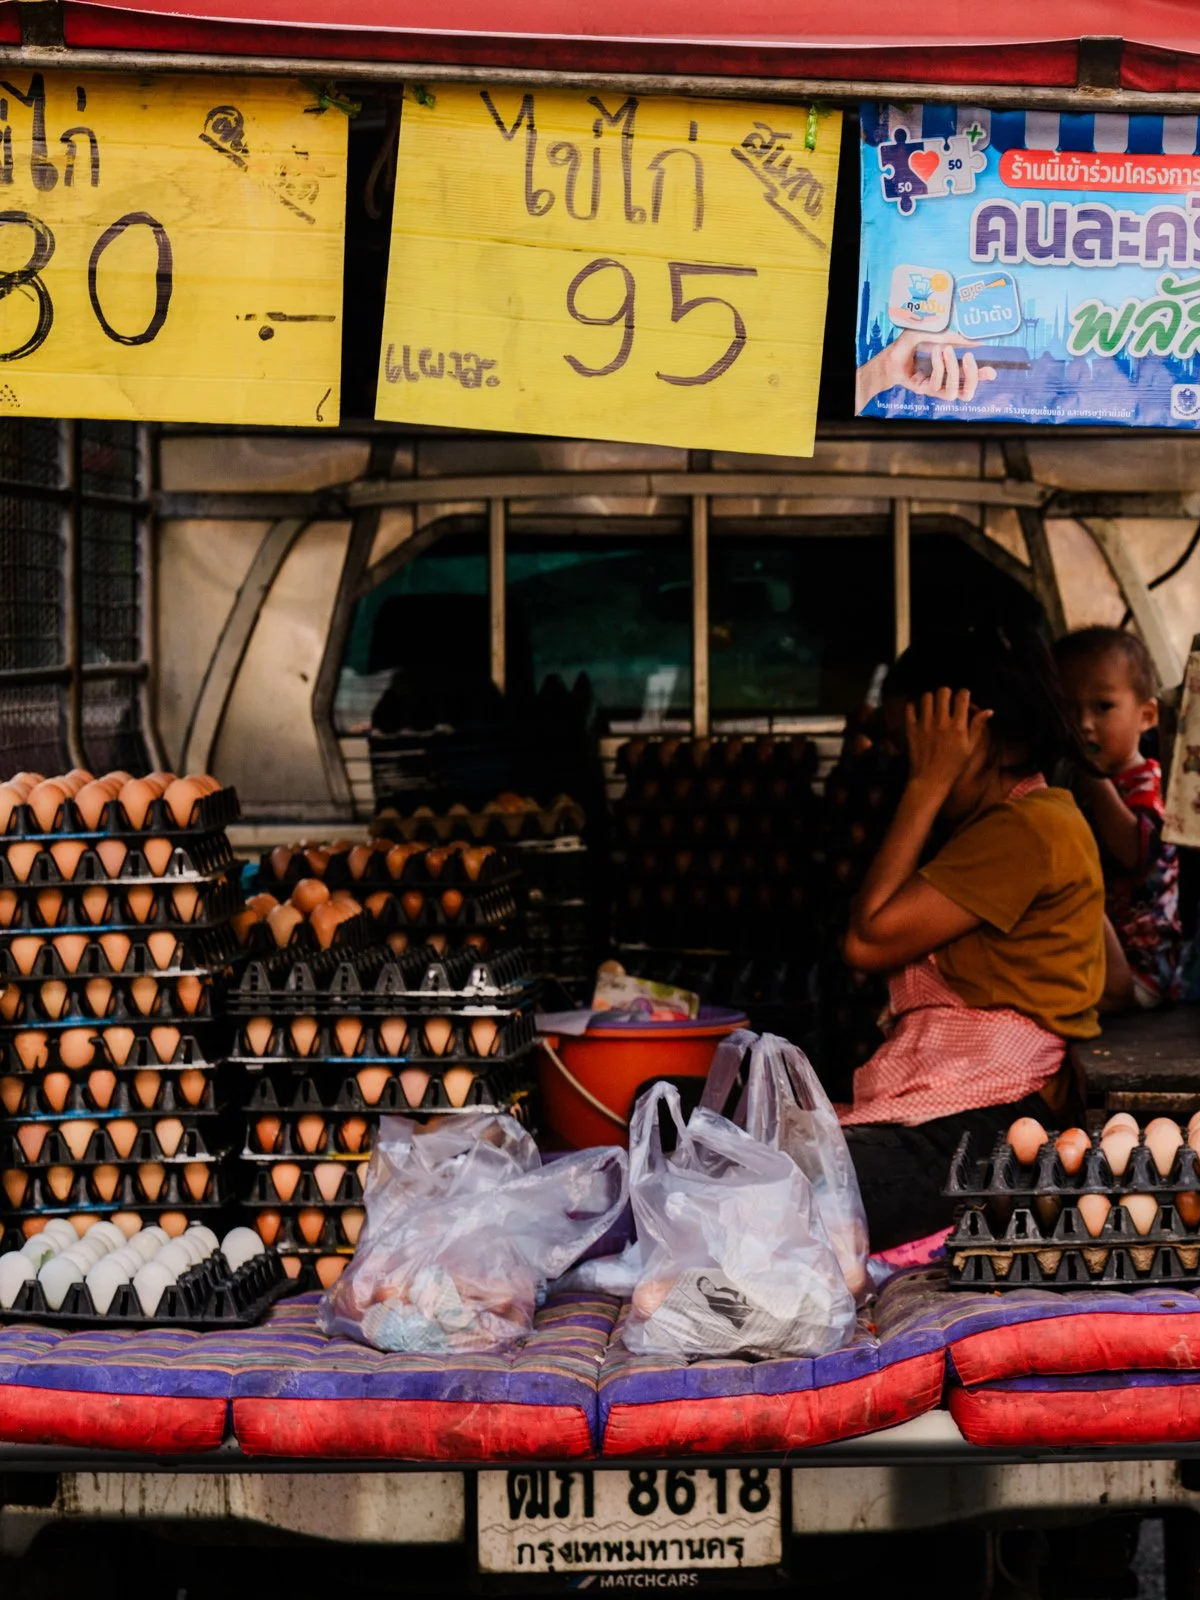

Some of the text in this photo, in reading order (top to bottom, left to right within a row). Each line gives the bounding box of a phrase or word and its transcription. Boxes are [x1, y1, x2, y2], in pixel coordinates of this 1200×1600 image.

[479, 90, 705, 231] ไข่ไก่
[947, 158, 963, 171] 50
[897, 181, 913, 193] 50
[563, 256, 759, 387] 95
[627, 1468, 771, 1516] 8618
[517, 1536, 745, 1570] กรุงเทพมหานคร
[600, 1572, 699, 1588] MATCHCARS
